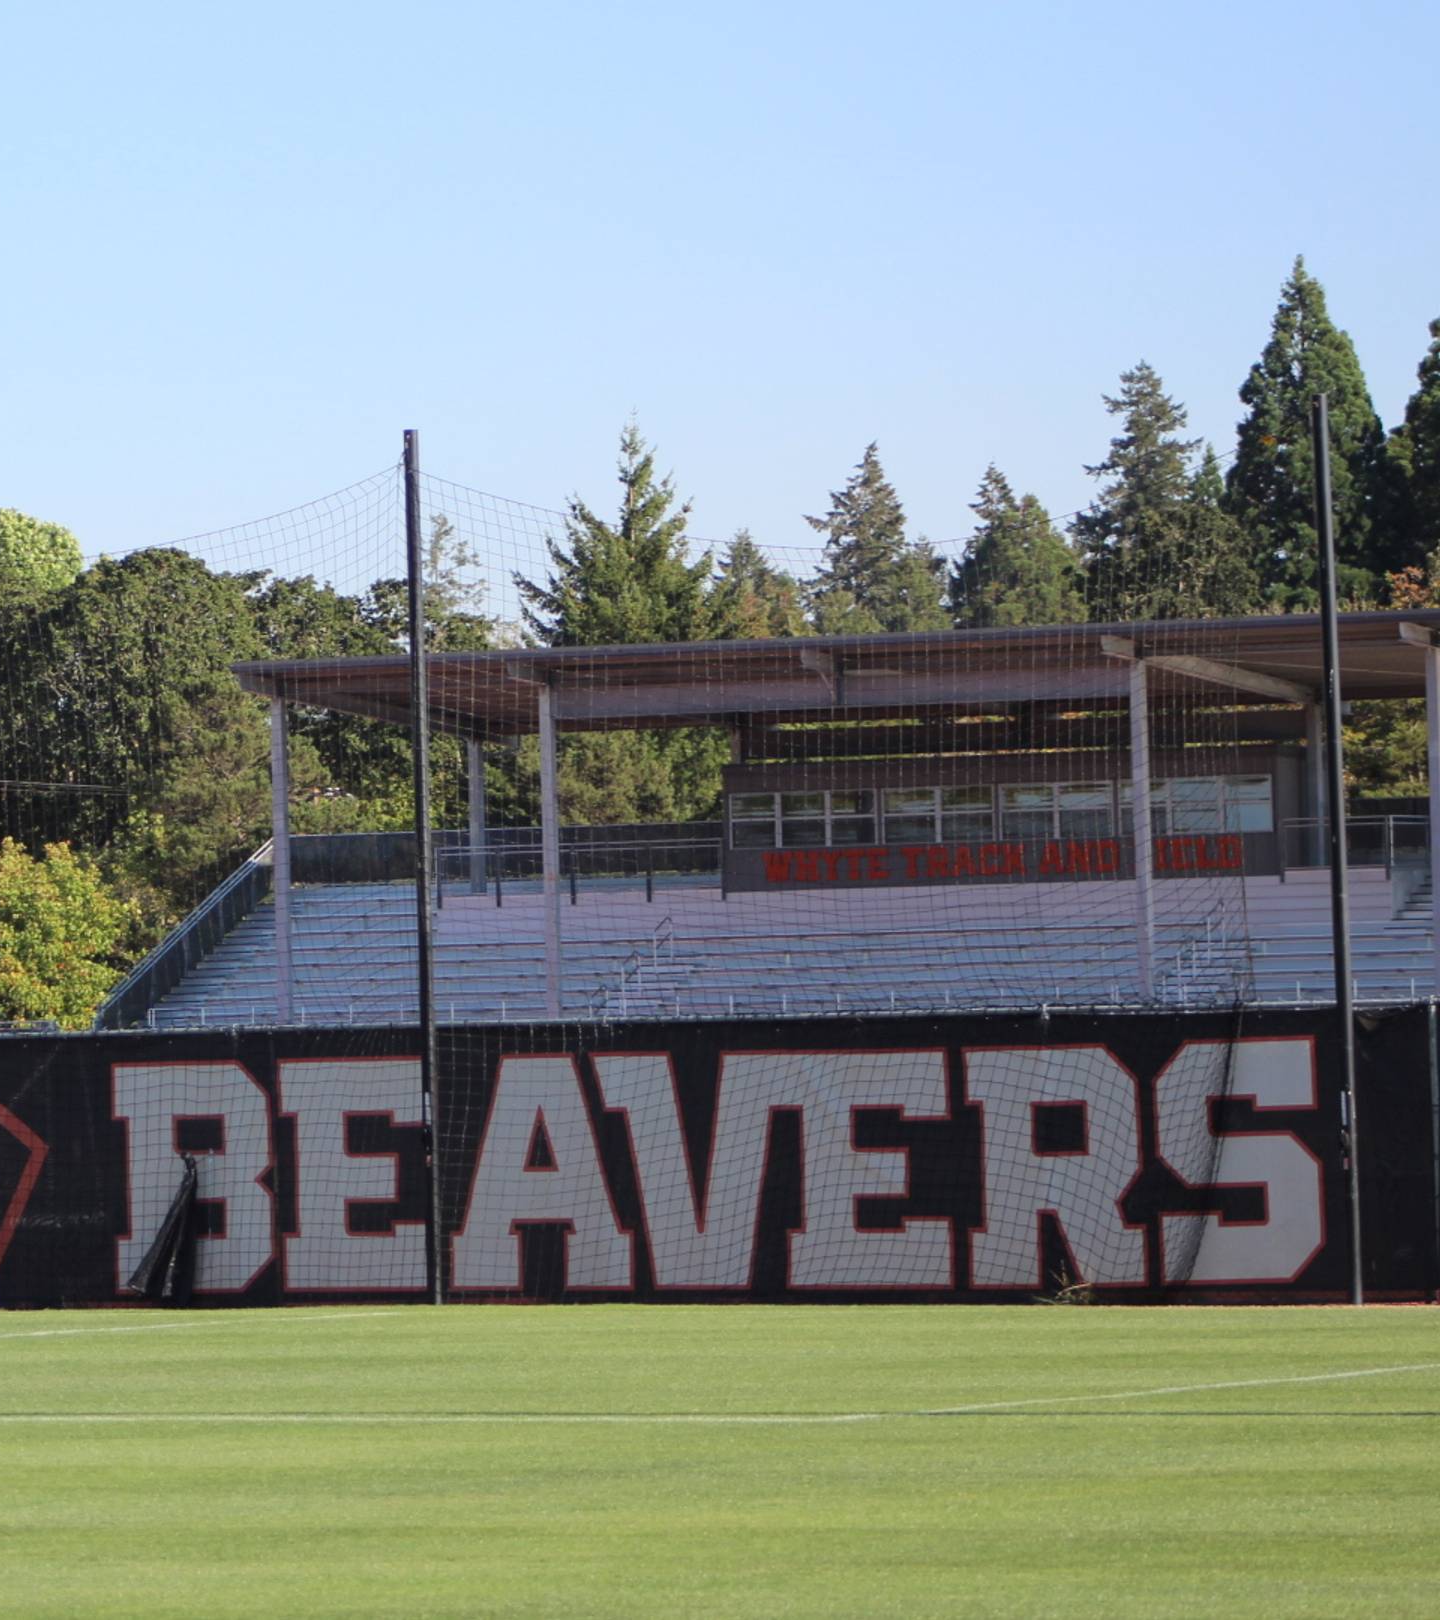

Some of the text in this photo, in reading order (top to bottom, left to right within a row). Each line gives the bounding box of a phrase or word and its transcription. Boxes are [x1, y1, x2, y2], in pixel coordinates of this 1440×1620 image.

[763, 836, 1242, 882] WHYTE TRACK AND IELD
[111, 1036, 1326, 1293] BEAVERS
